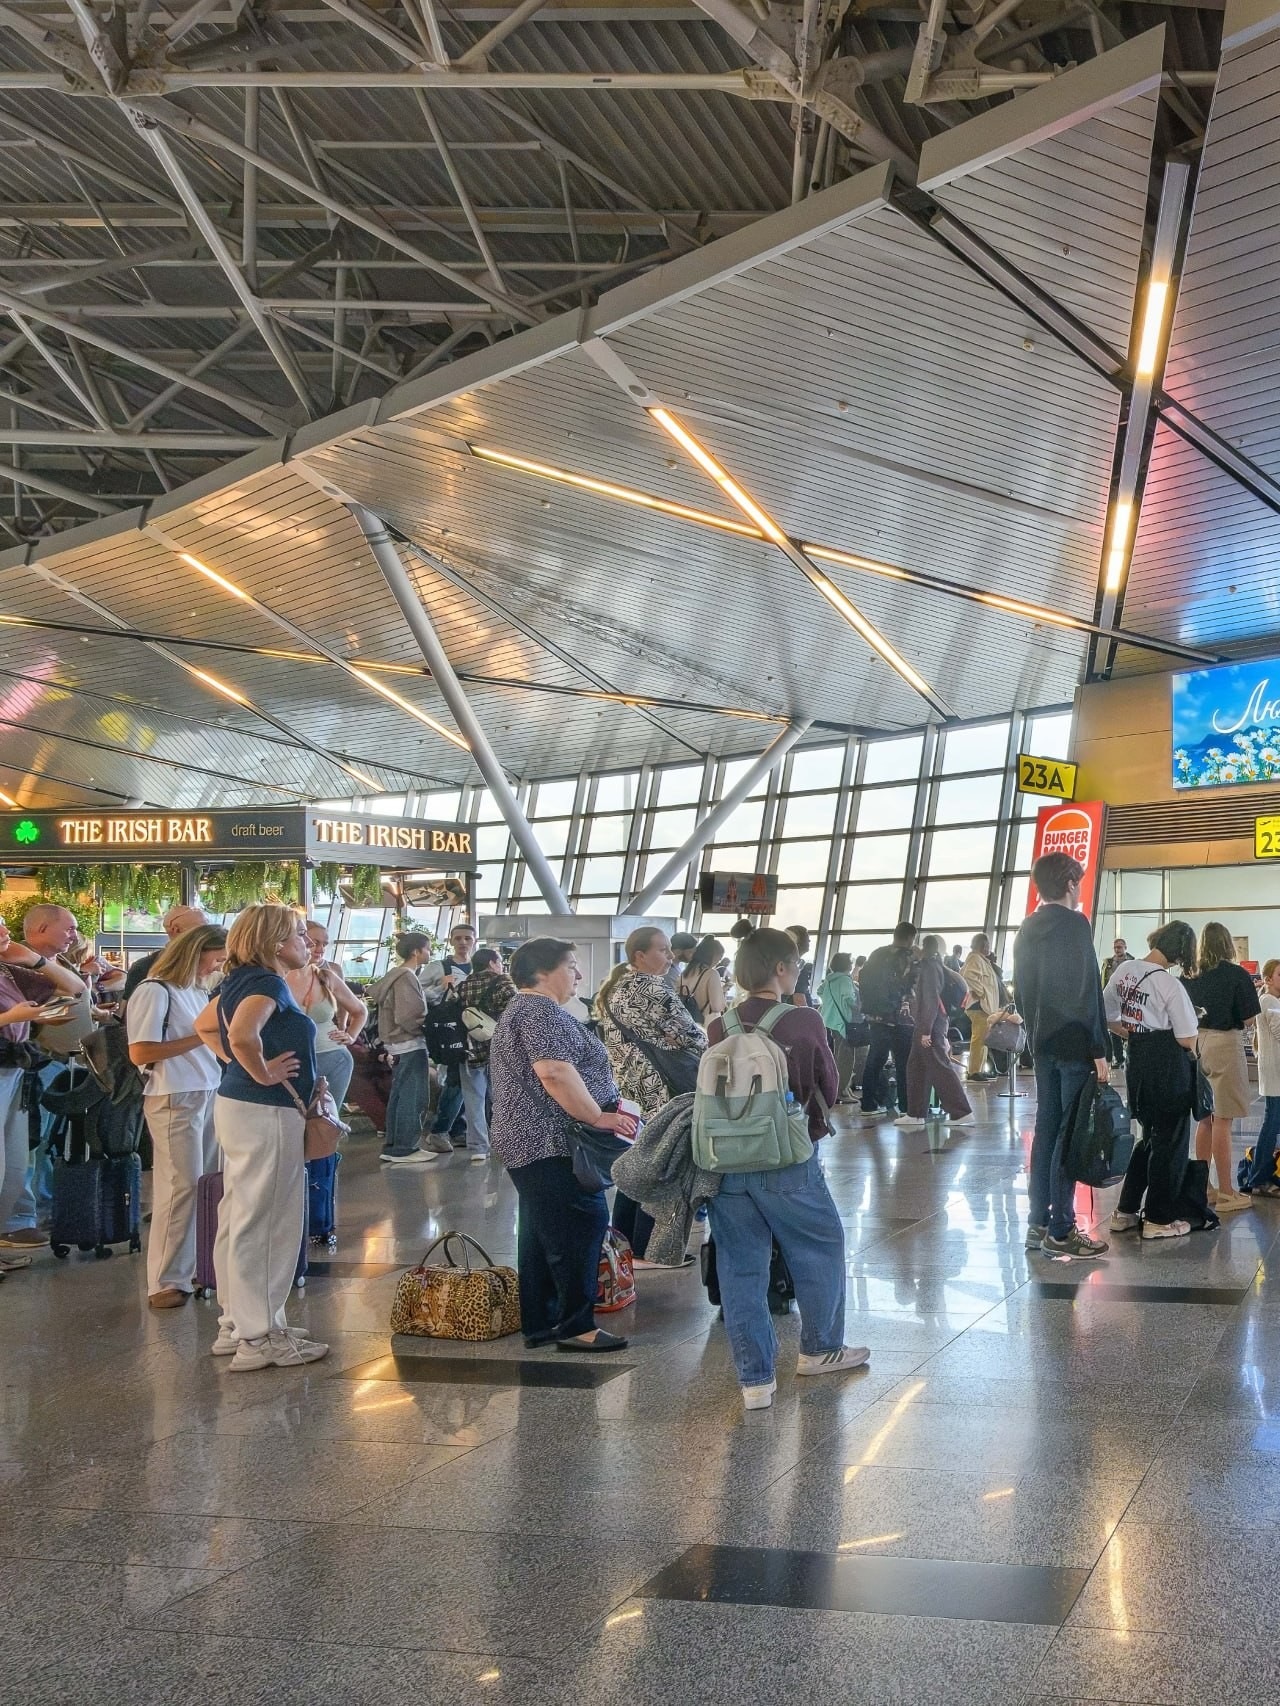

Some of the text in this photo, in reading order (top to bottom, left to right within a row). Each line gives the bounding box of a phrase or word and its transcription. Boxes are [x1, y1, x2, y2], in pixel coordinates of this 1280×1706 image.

[1022, 761, 1065, 792] 23A
[60, 818, 212, 844] THE IRISH BAR
[231, 823, 285, 837] draft beer
[314, 819, 473, 854] THE IRISH BAR
[1044, 830, 1088, 846] BURGER
